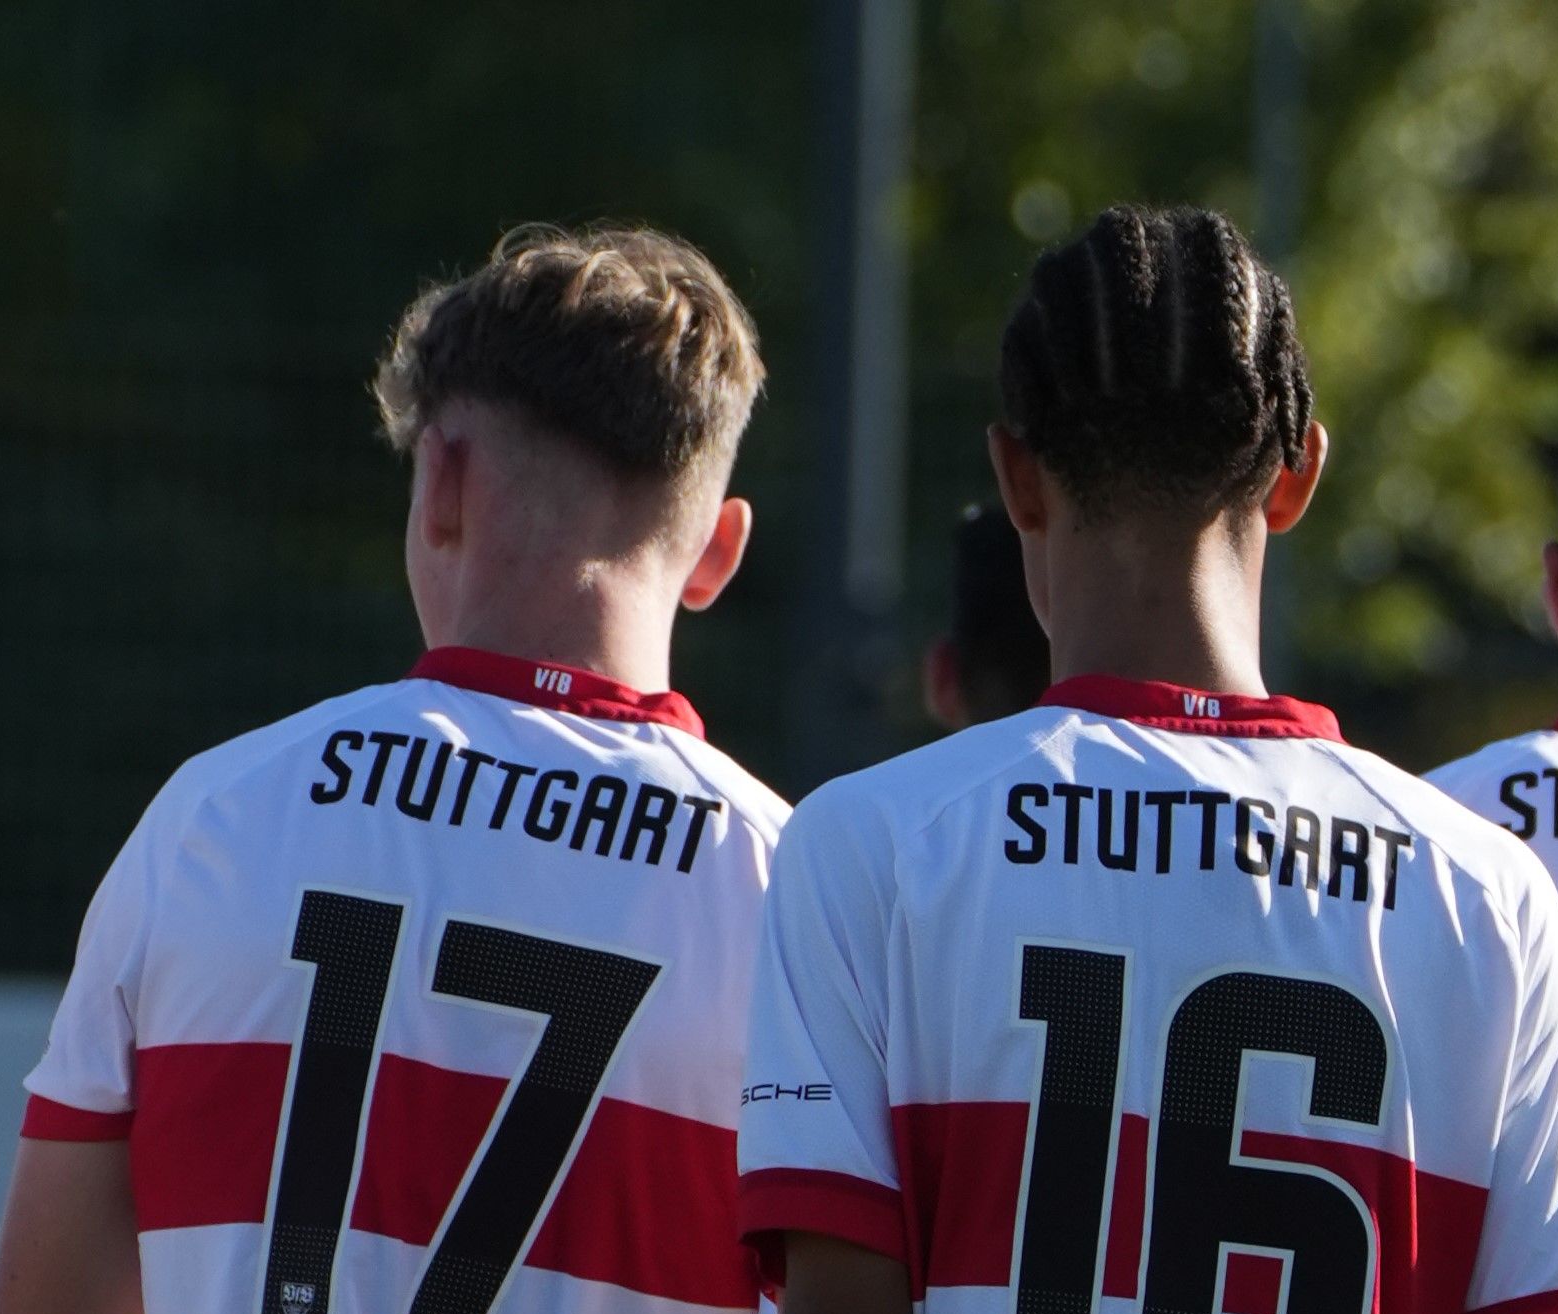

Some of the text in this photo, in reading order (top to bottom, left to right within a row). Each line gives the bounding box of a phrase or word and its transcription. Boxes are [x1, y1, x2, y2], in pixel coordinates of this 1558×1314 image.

[535, 667, 572, 695] VfB
[1183, 693, 1220, 718] VfB
[310, 731, 721, 874] STUTTGART
[1004, 783, 1411, 910] STUTTGART
